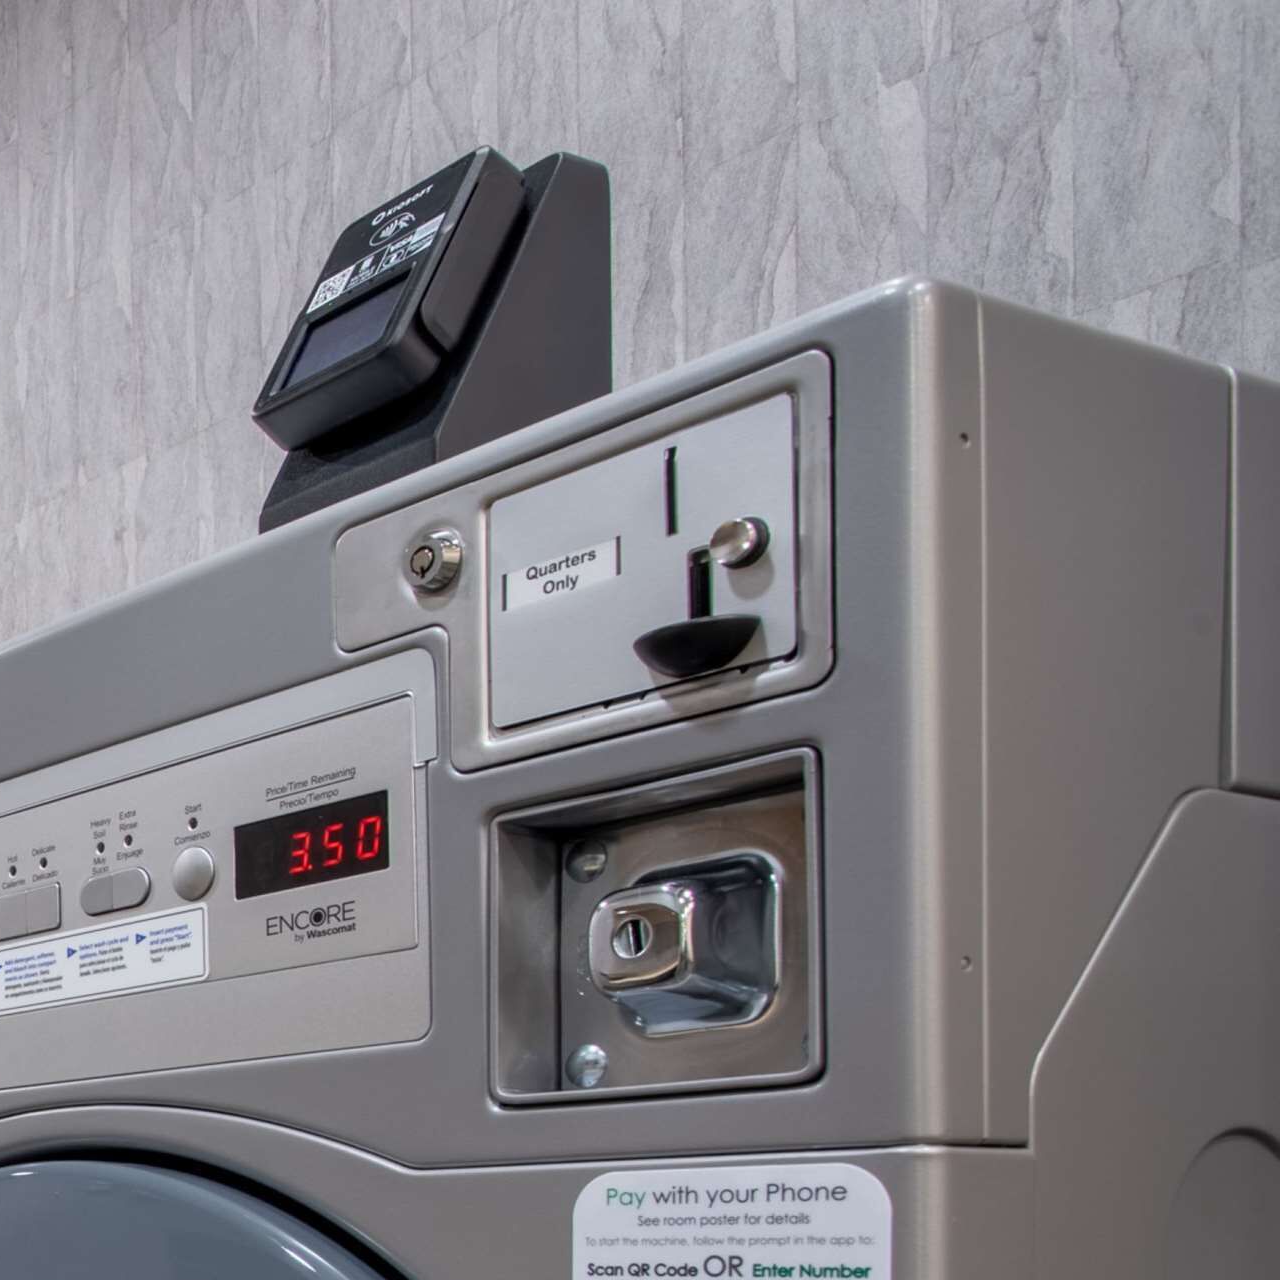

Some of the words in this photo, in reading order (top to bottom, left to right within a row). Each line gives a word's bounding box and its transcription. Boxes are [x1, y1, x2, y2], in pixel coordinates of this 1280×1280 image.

[526, 550, 597, 580] Quarters
[543, 574, 579, 594] Only
[311, 767, 356, 785] Remaining
[185, 803, 202, 815] Start
[289, 815, 382, 874] 3.50
[266, 900, 356, 937] ENCORE
[294, 932, 305, 943] by
[306, 922, 357, 940] Wascomat
[605, 1188, 646, 1209] Pay
[652, 1185, 699, 1205] with
[706, 1186, 758, 1208] your
[766, 1183, 848, 1202] Phone
[637, 1215, 660, 1227] See
[663, 1216, 696, 1226] room
[699, 1214, 740, 1228] poster
[744, 1212, 762, 1226] for
[765, 1212, 811, 1226] details
[585, 1236, 596, 1247] To
[598, 1236, 619, 1247] start
[621, 1236, 638, 1247] the
[641, 1236, 689, 1248] machine,
[693, 1235, 724, 1246] follow
[727, 1235, 745, 1246] the
[748, 1235, 791, 1249] prompt
[794, 1235, 803, 1246] in
[807, 1235, 826, 1246] the
[829, 1237, 856, 1248] app
[858, 1235, 876, 1246] to:
[587, 1263, 625, 1278] Scan
[627, 1263, 651, 1278] QR
[654, 1263, 699, 1278] Code
[703, 1255, 744, 1278] OR
[752, 1263, 795, 1278] Enter
[799, 1263, 872, 1279] Number
